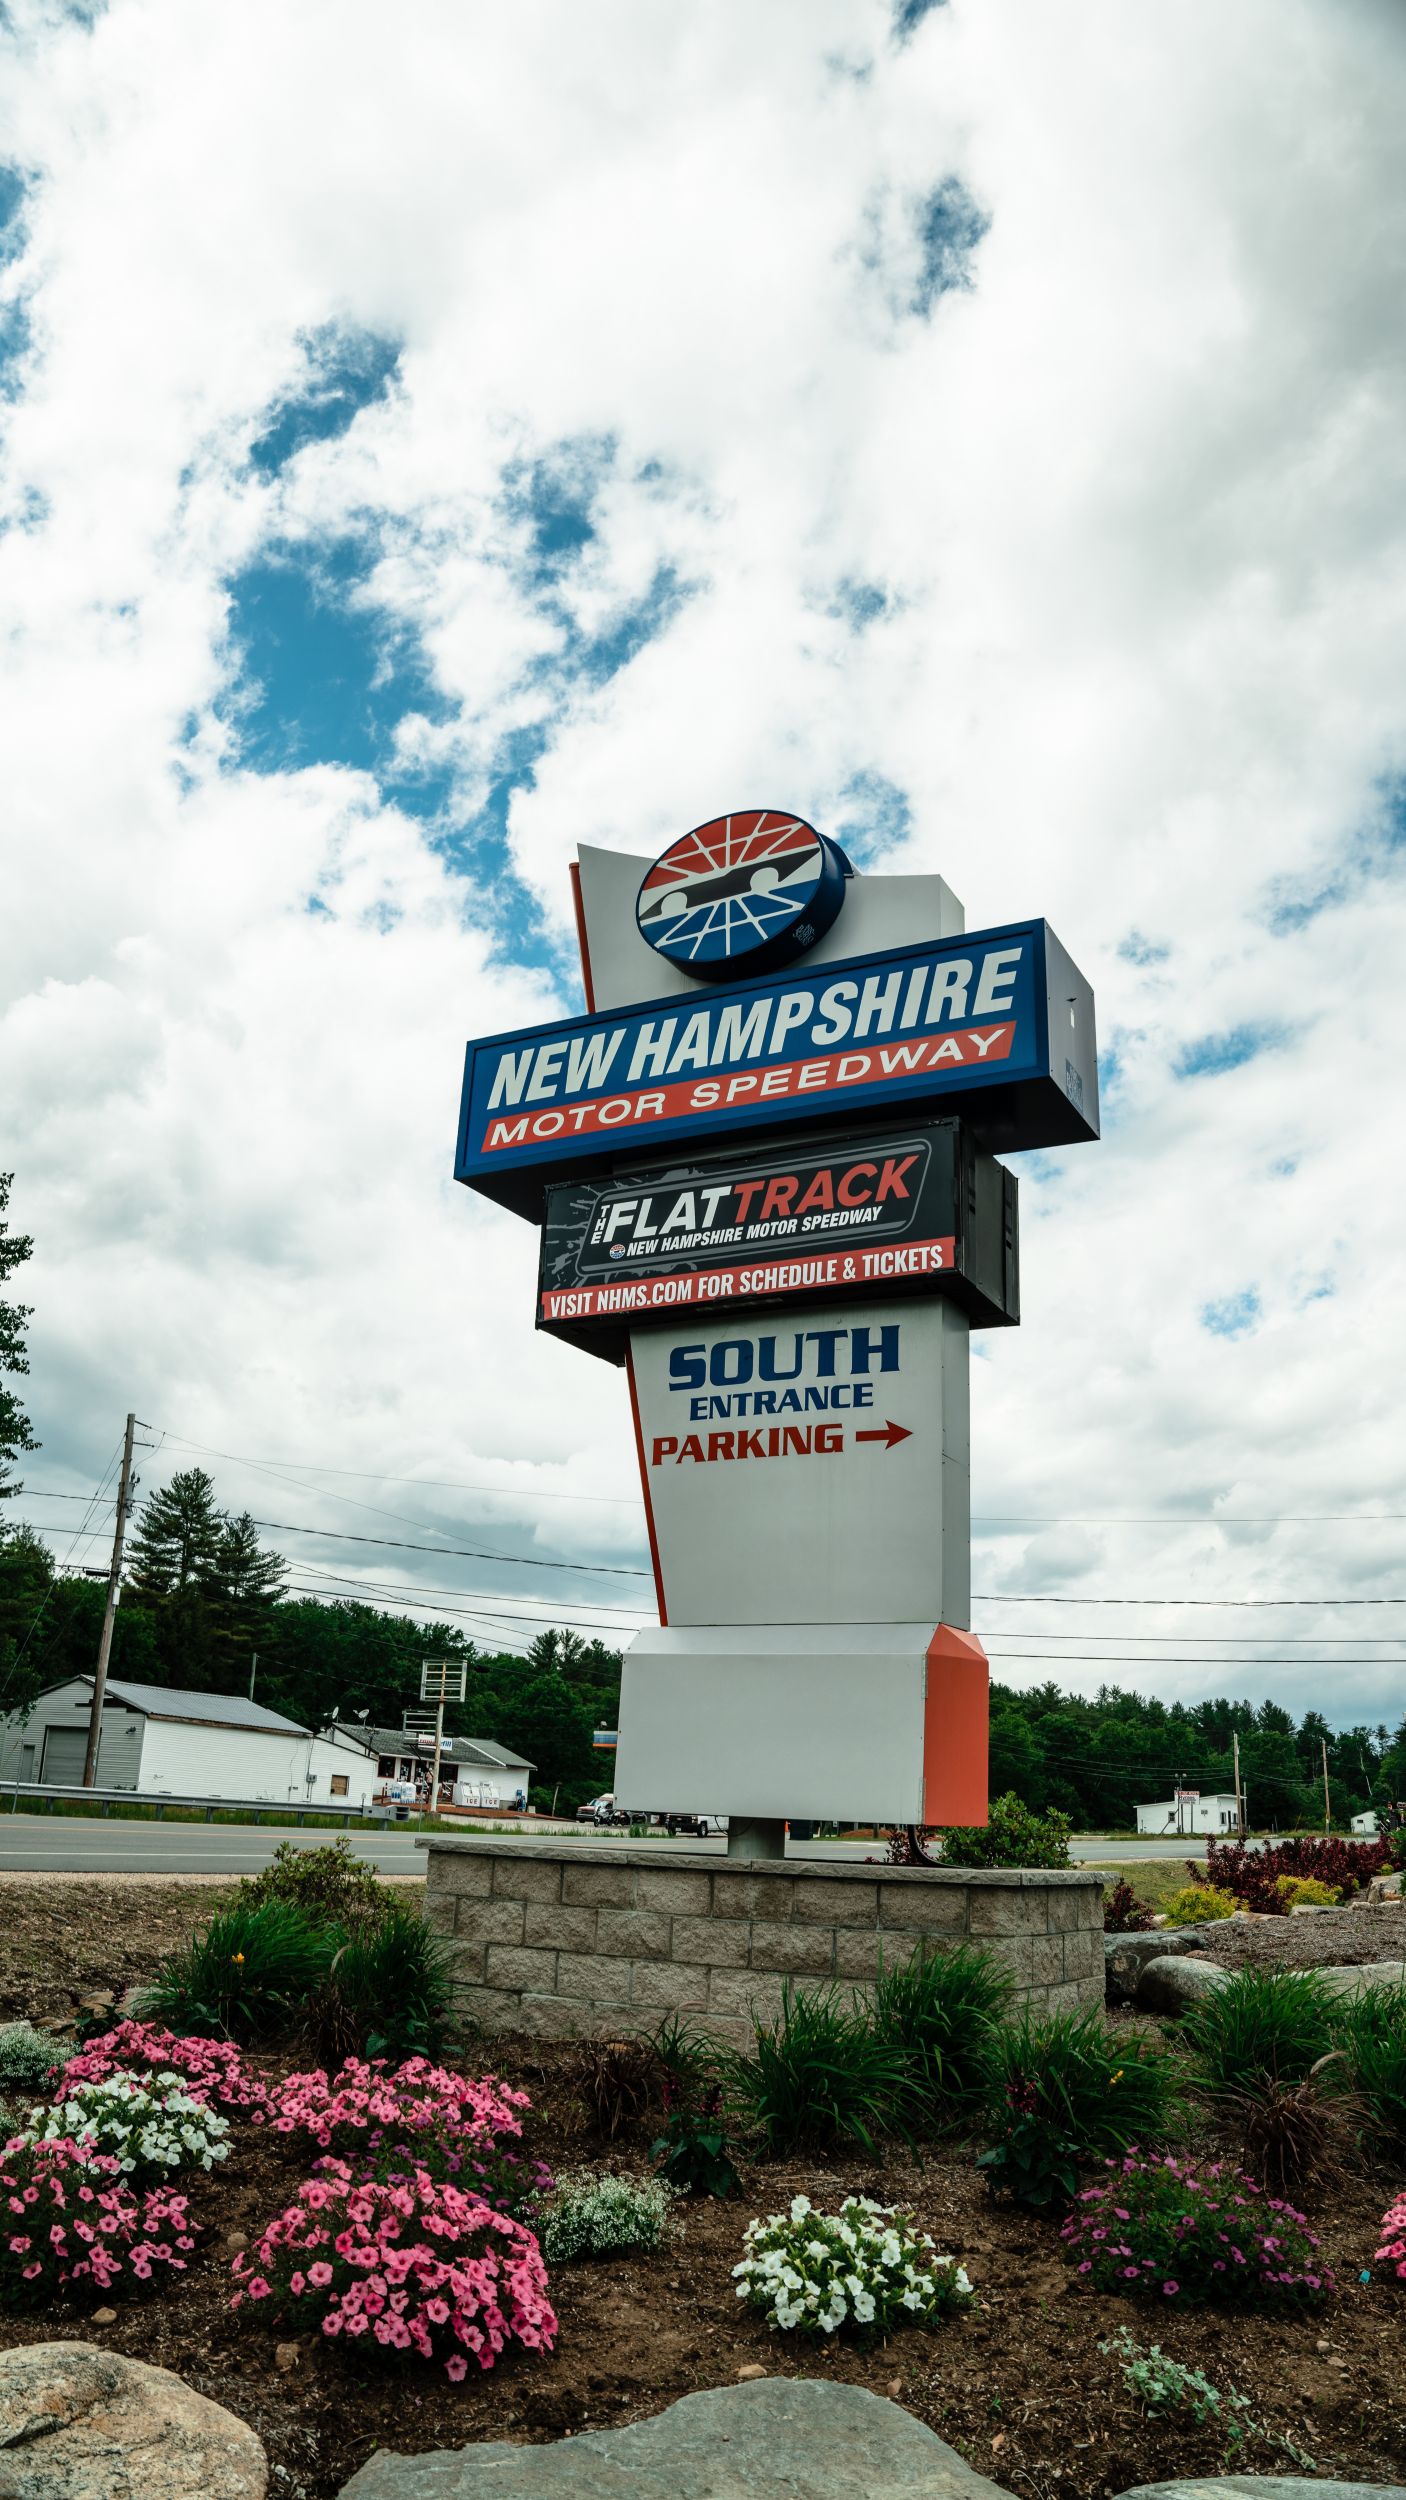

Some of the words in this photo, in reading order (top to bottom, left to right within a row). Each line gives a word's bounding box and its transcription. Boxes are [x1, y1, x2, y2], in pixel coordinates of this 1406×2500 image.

[486, 1028, 626, 1110] NEW
[626, 947, 1023, 1082] HAMPSHIRE
[489, 1092, 666, 1146] MOTOR
[690, 1028, 1007, 1108] SPEEDWAY
[590, 1204, 611, 1245] THE
[626, 1239, 659, 1257] NEW
[660, 1226, 743, 1252] HAMPSHIRE
[746, 1218, 798, 1240] MOTOR
[801, 1205, 883, 1232] SPEEDWAY
[550, 1292, 593, 1318] VISIT
[597, 1278, 692, 1312] NHMS.COM
[697, 1273, 734, 1298] FOR
[739, 1259, 837, 1293] SCHEDULE
[842, 1257, 856, 1280] &
[862, 1245, 943, 1278] TICKETS
[669, 1325, 900, 1391] SOUTH
[690, 1383, 873, 1421] ENTRANCE
[651, 1423, 844, 1466] PARKING
